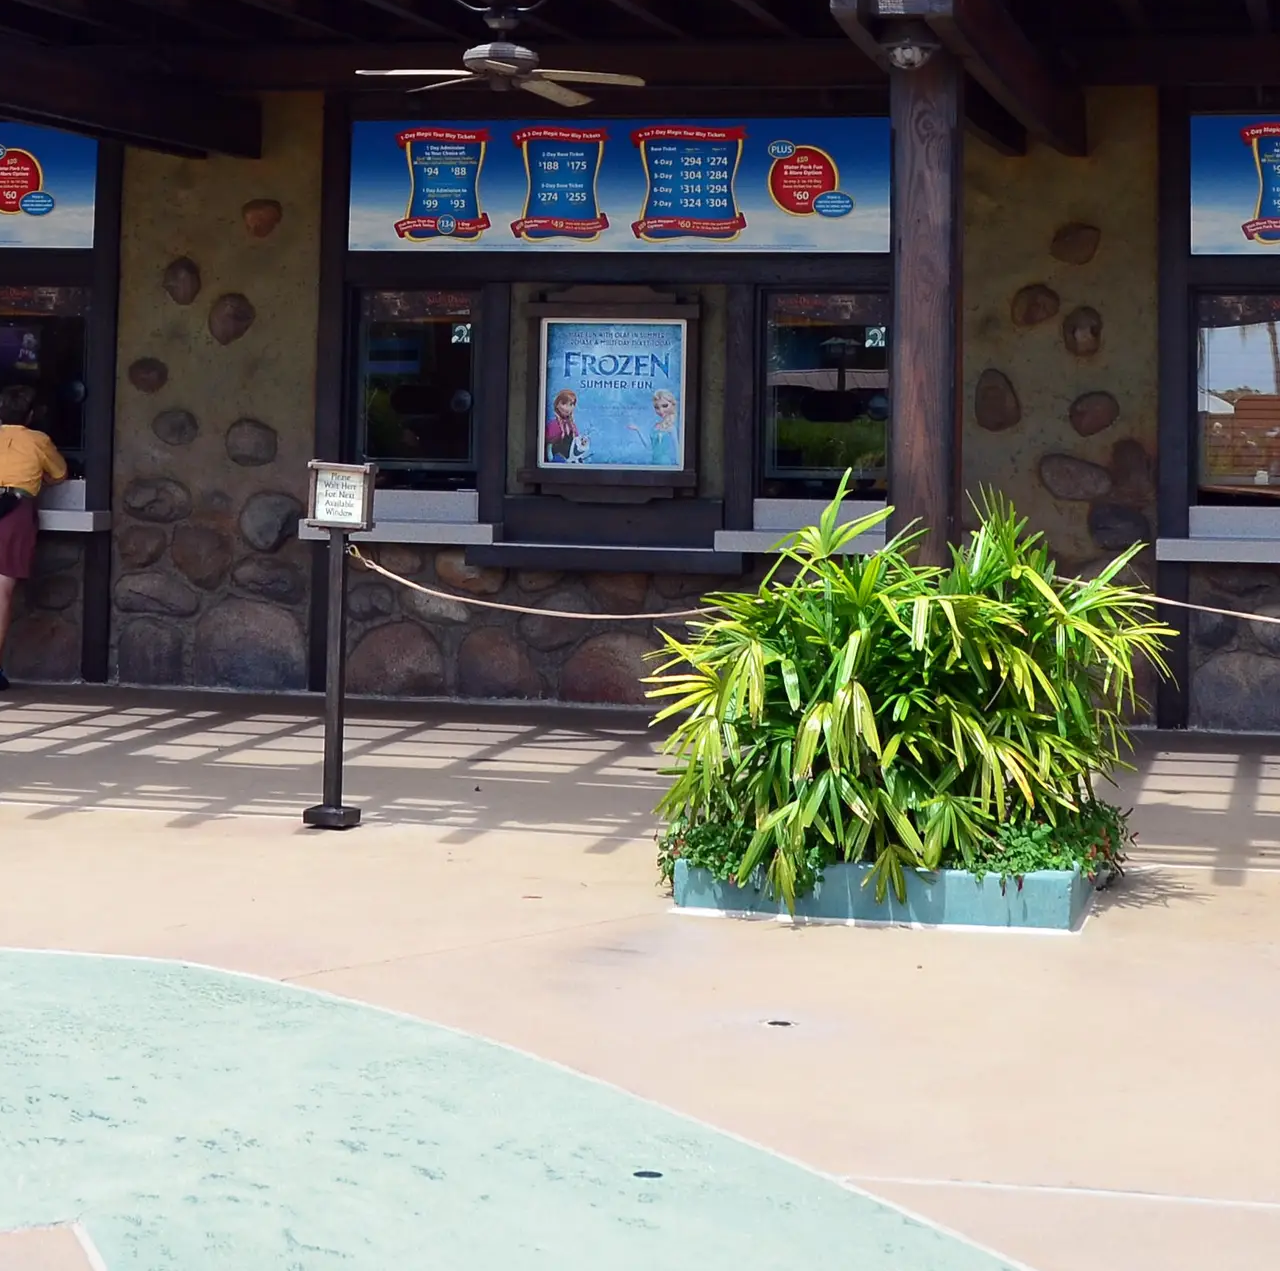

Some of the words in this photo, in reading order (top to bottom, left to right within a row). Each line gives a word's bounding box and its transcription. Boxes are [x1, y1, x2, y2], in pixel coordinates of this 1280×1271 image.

[681, 157, 701, 166] $294
[706, 157, 727, 166] $274
[539, 162, 559, 170] $188
[567, 162, 587, 170] $175
[424, 167, 438, 175] $94
[451, 167, 466, 175] $88
[680, 171, 701, 179] $304
[707, 171, 727, 179] $284
[680, 185, 701, 193] $314
[707, 185, 727, 193] $294
[3, 191, 16, 199] $60
[538, 193, 558, 201] $274
[566, 193, 586, 201] $255
[793, 191, 809, 200] $60
[423, 200, 438, 208] $99
[451, 200, 465, 208] $93
[680, 198, 701, 207] $324
[706, 198, 727, 207] $304
[564, 351, 670, 378] FROZEN
[580, 380, 627, 389] SUMMER
[632, 381, 652, 389] FUN
